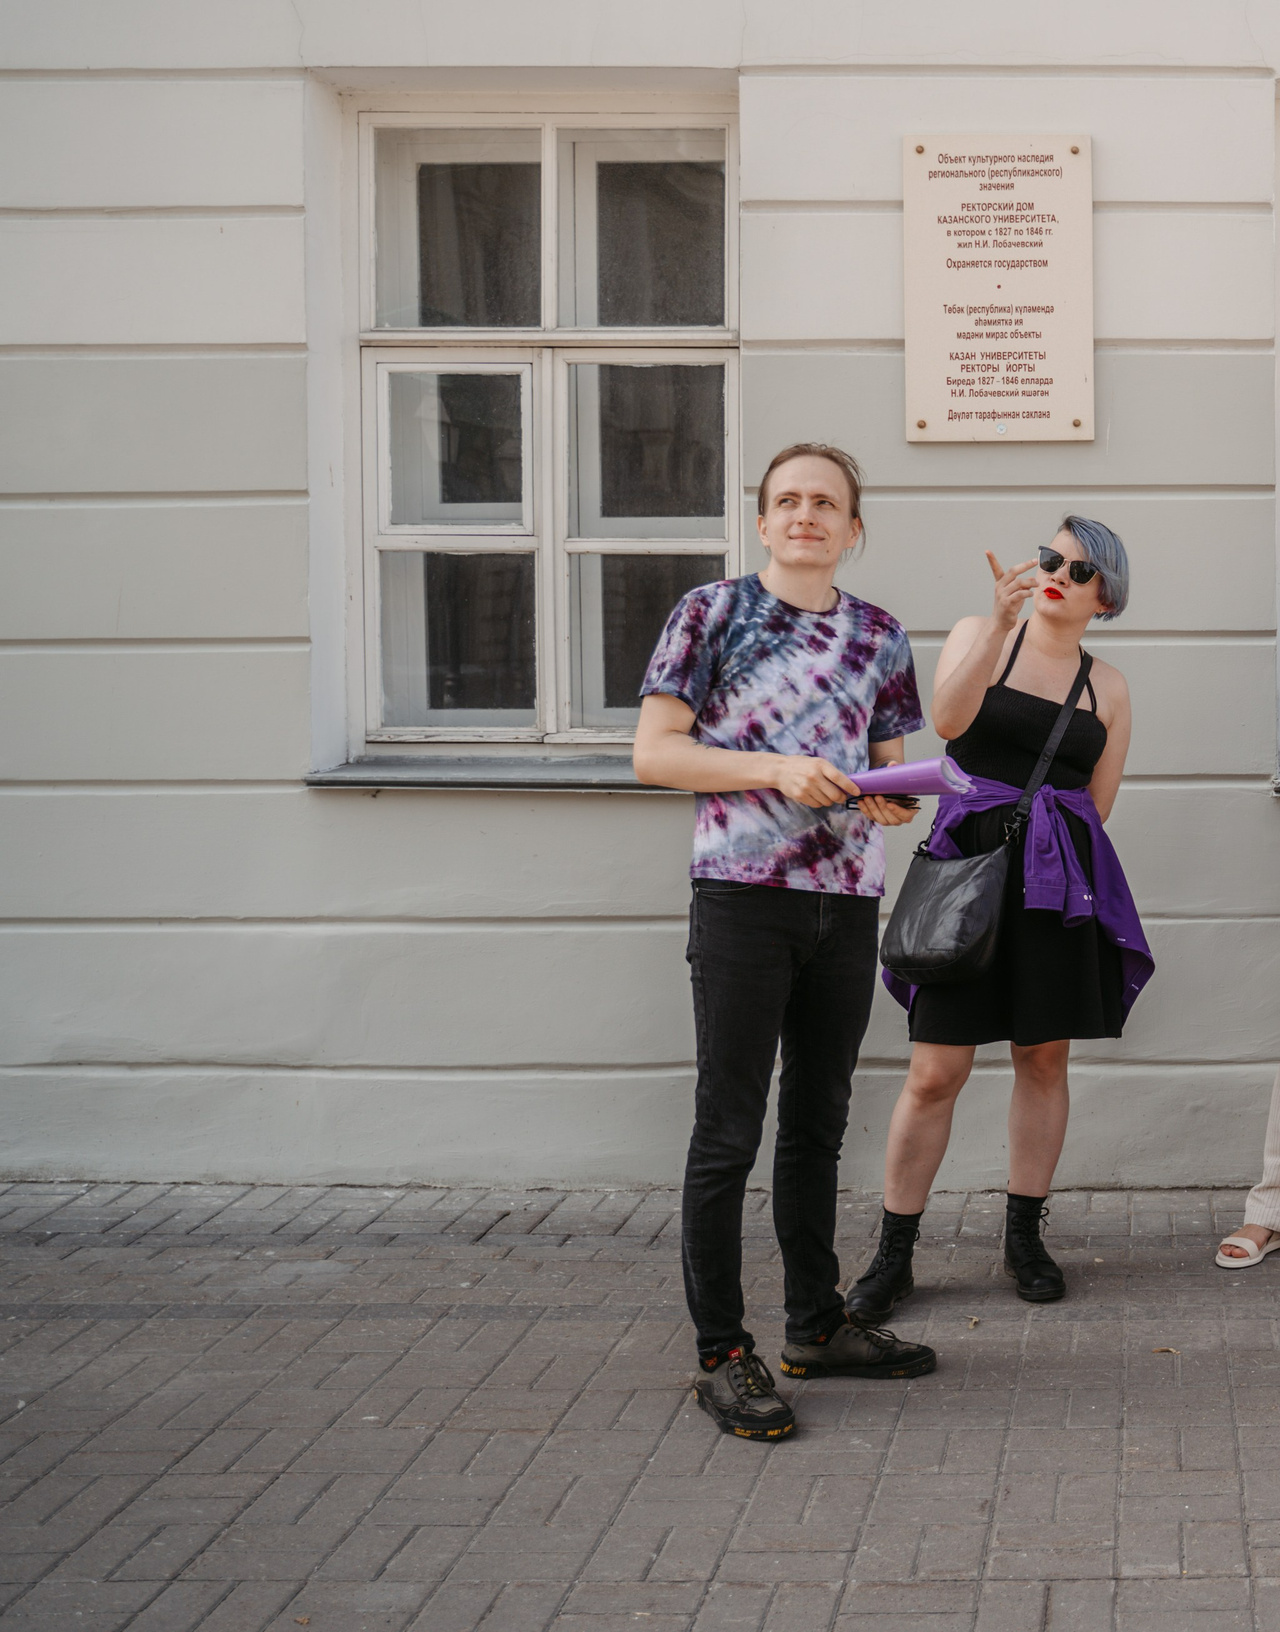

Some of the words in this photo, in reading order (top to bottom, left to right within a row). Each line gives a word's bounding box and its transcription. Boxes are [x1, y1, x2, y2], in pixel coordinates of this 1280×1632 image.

[938, 154, 966, 164] Объект
[968, 155, 1015, 166] культурного
[1017, 154, 1054, 164] наследия
[928, 170, 986, 181] регионального
[988, 167, 1063, 180] (республиканского)
[979, 181, 1015, 191] значения
[961, 201, 1014, 212] РЕКТОРСКИЙ
[1016, 202, 1035, 212] ДОМ
[937, 214, 991, 224] КАЗАНСКОГО
[993, 213, 1060, 223] УНИВЕРСИТЕТА,
[947, 229, 952, 238] в
[954, 229, 986, 238] котором
[987, 229, 992, 237] с
[994, 226, 1012, 236] 1827
[1014, 228, 1024, 237] по
[1025, 226, 1043, 236] 1846
[1045, 228, 1054, 236] гг.
[957, 241, 972, 249] жил
[974, 239, 990, 249] Н.И.
[992, 238, 1043, 248] Лобачевский
[946, 258, 992, 271] Охраняется
[994, 260, 1049, 270] государством
[943, 304, 964, 314] Төбәк
[966, 304, 1013, 316] (республика)
[1015, 305, 1055, 315] күләмендә
[974, 316, 1012, 326] әһәмияткә
[1014, 318, 1024, 327] ия
[957, 331, 983, 341] мәдәни
[985, 331, 1008, 341] мирас
[1010, 329, 1042, 339] объекты
[949, 351, 976, 361] КАЗАН
[980, 350, 1047, 360] УНИВЕРСИТЕТЫ
[961, 363, 999, 373] РЕКТОРЫ
[1006, 362, 1036, 372] ЙОРТЫ
[946, 377, 975, 387] Биредә
[977, 375, 995, 385] 1827
[1001, 375, 1019, 385] 1846
[1020, 377, 1053, 387] елларда
[950, 388, 966, 398] Н.И.
[968, 388, 1020, 398] Лобачевский
[1021, 388, 1050, 398] яшәгән
[948, 409, 973, 422] Дәүләт
[974, 409, 1021, 422] тарафыннан
[1022, 410, 1051, 420] саклана
